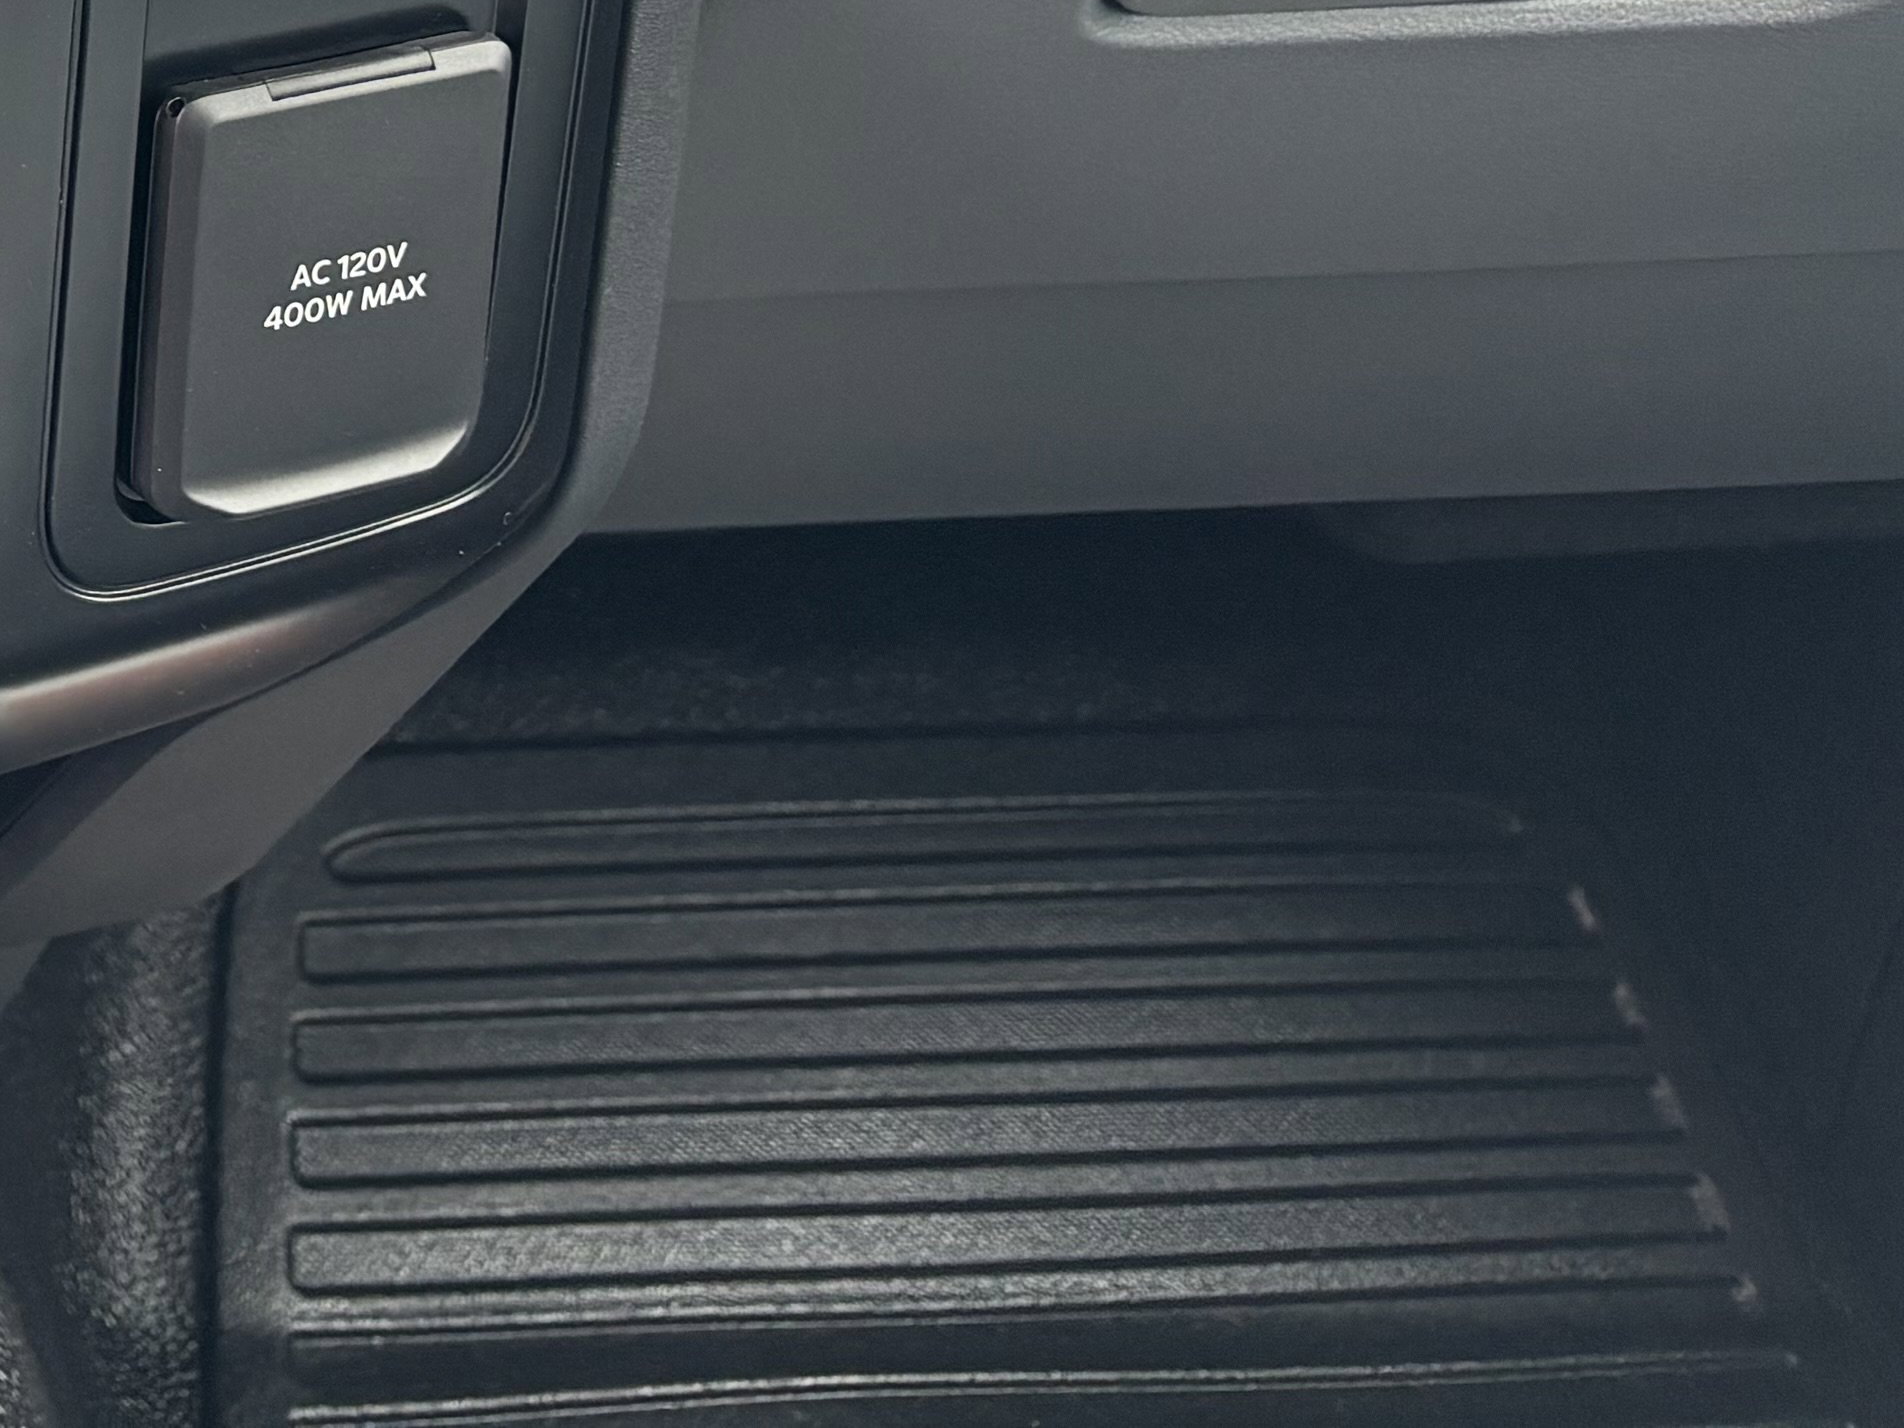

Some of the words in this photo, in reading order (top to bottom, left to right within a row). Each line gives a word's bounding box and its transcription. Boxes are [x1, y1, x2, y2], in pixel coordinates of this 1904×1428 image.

[290, 258, 332, 291] AC
[337, 241, 408, 280] 120V
[263, 289, 354, 330] 400W
[360, 272, 427, 311] MAX
